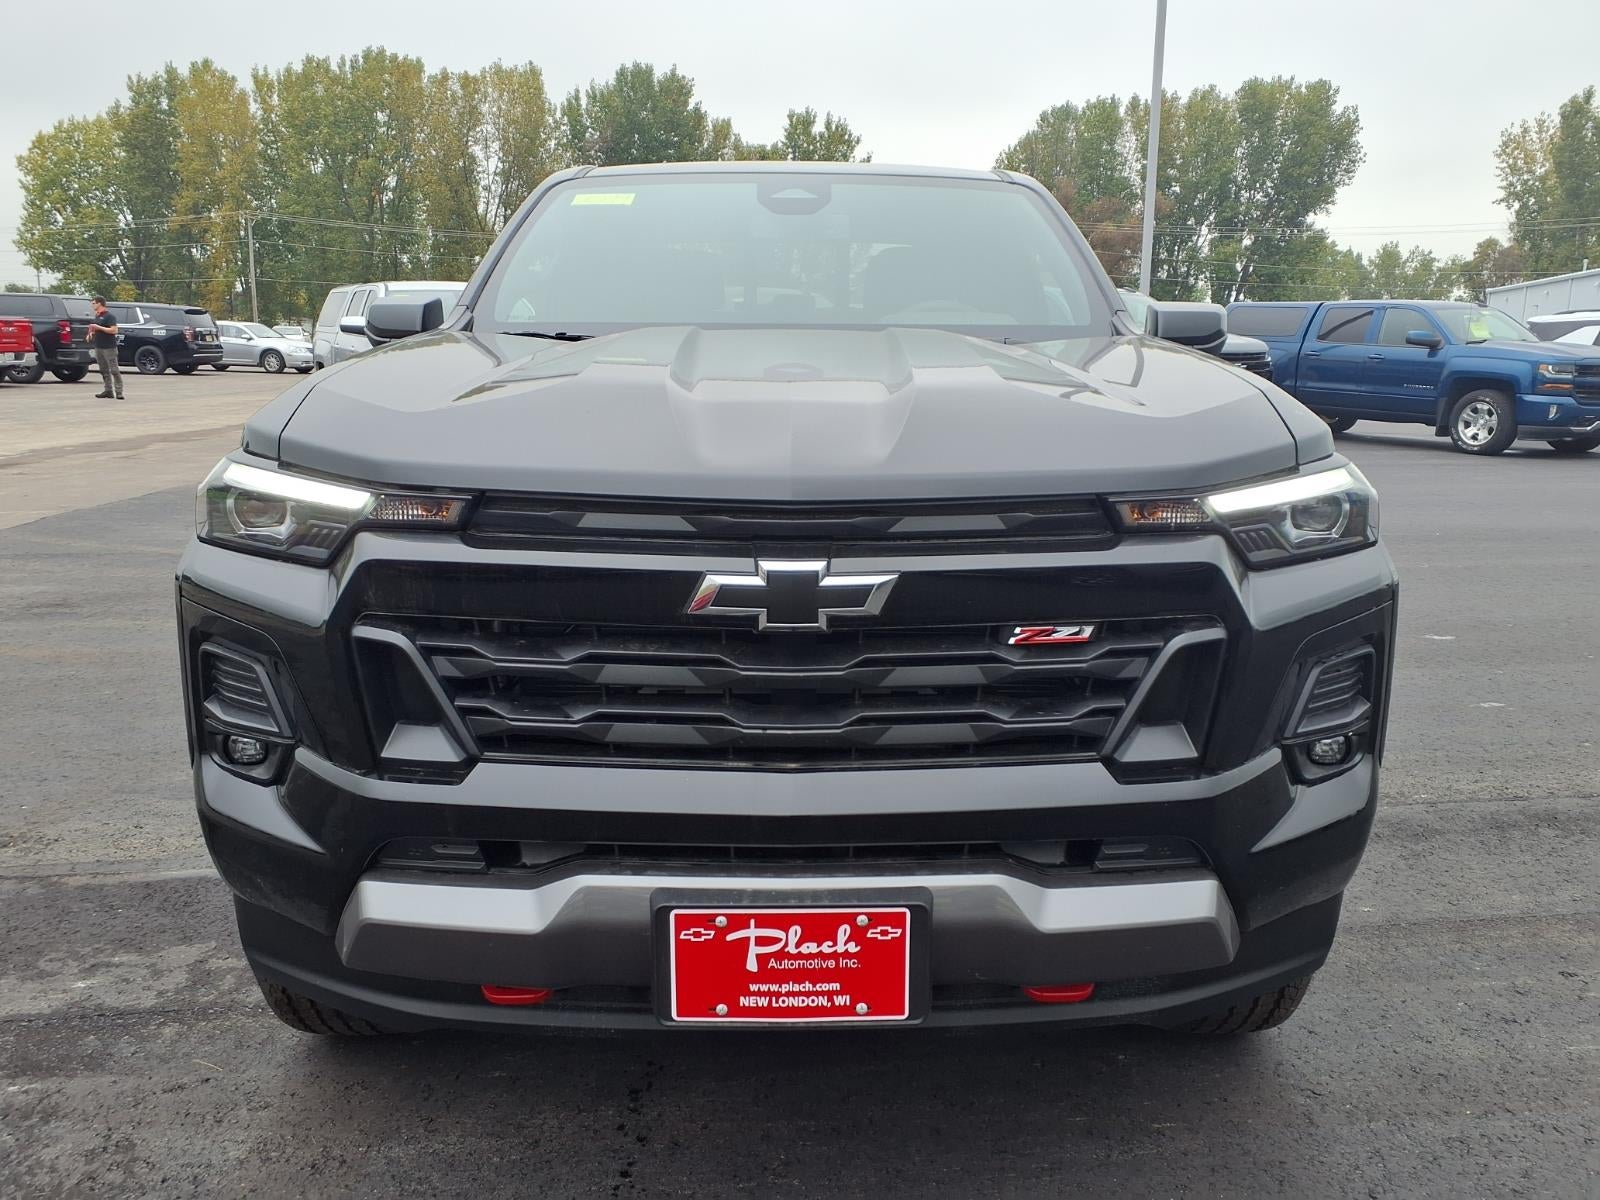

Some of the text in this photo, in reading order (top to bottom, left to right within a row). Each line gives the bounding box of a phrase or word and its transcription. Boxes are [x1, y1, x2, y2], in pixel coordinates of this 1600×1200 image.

[1008, 625, 1095, 646] Z71
[726, 918, 861, 972] Plach
[767, 956, 861, 970] Automotive Inc.
[749, 981, 841, 993] www.plach.com
[739, 994, 850, 1008] NEW LONDON, WI
